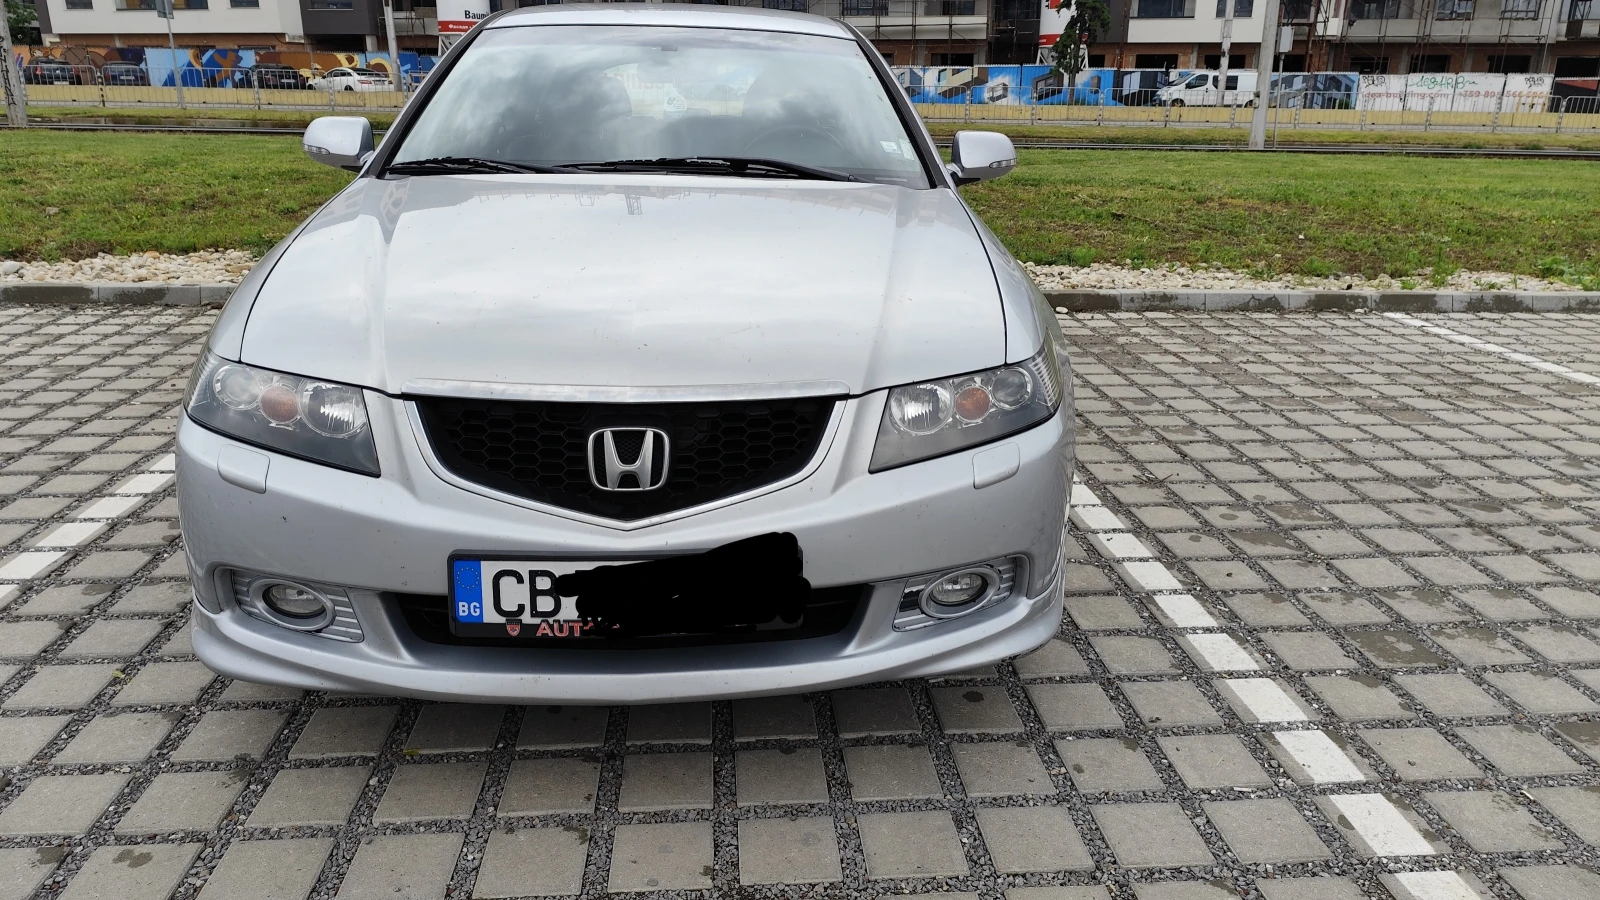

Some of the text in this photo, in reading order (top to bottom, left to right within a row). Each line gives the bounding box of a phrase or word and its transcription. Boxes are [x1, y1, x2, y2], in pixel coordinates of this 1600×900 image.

[464, 10, 490, 19] Baum
[458, 602, 480, 616] BG
[536, 621, 594, 637] AUT
